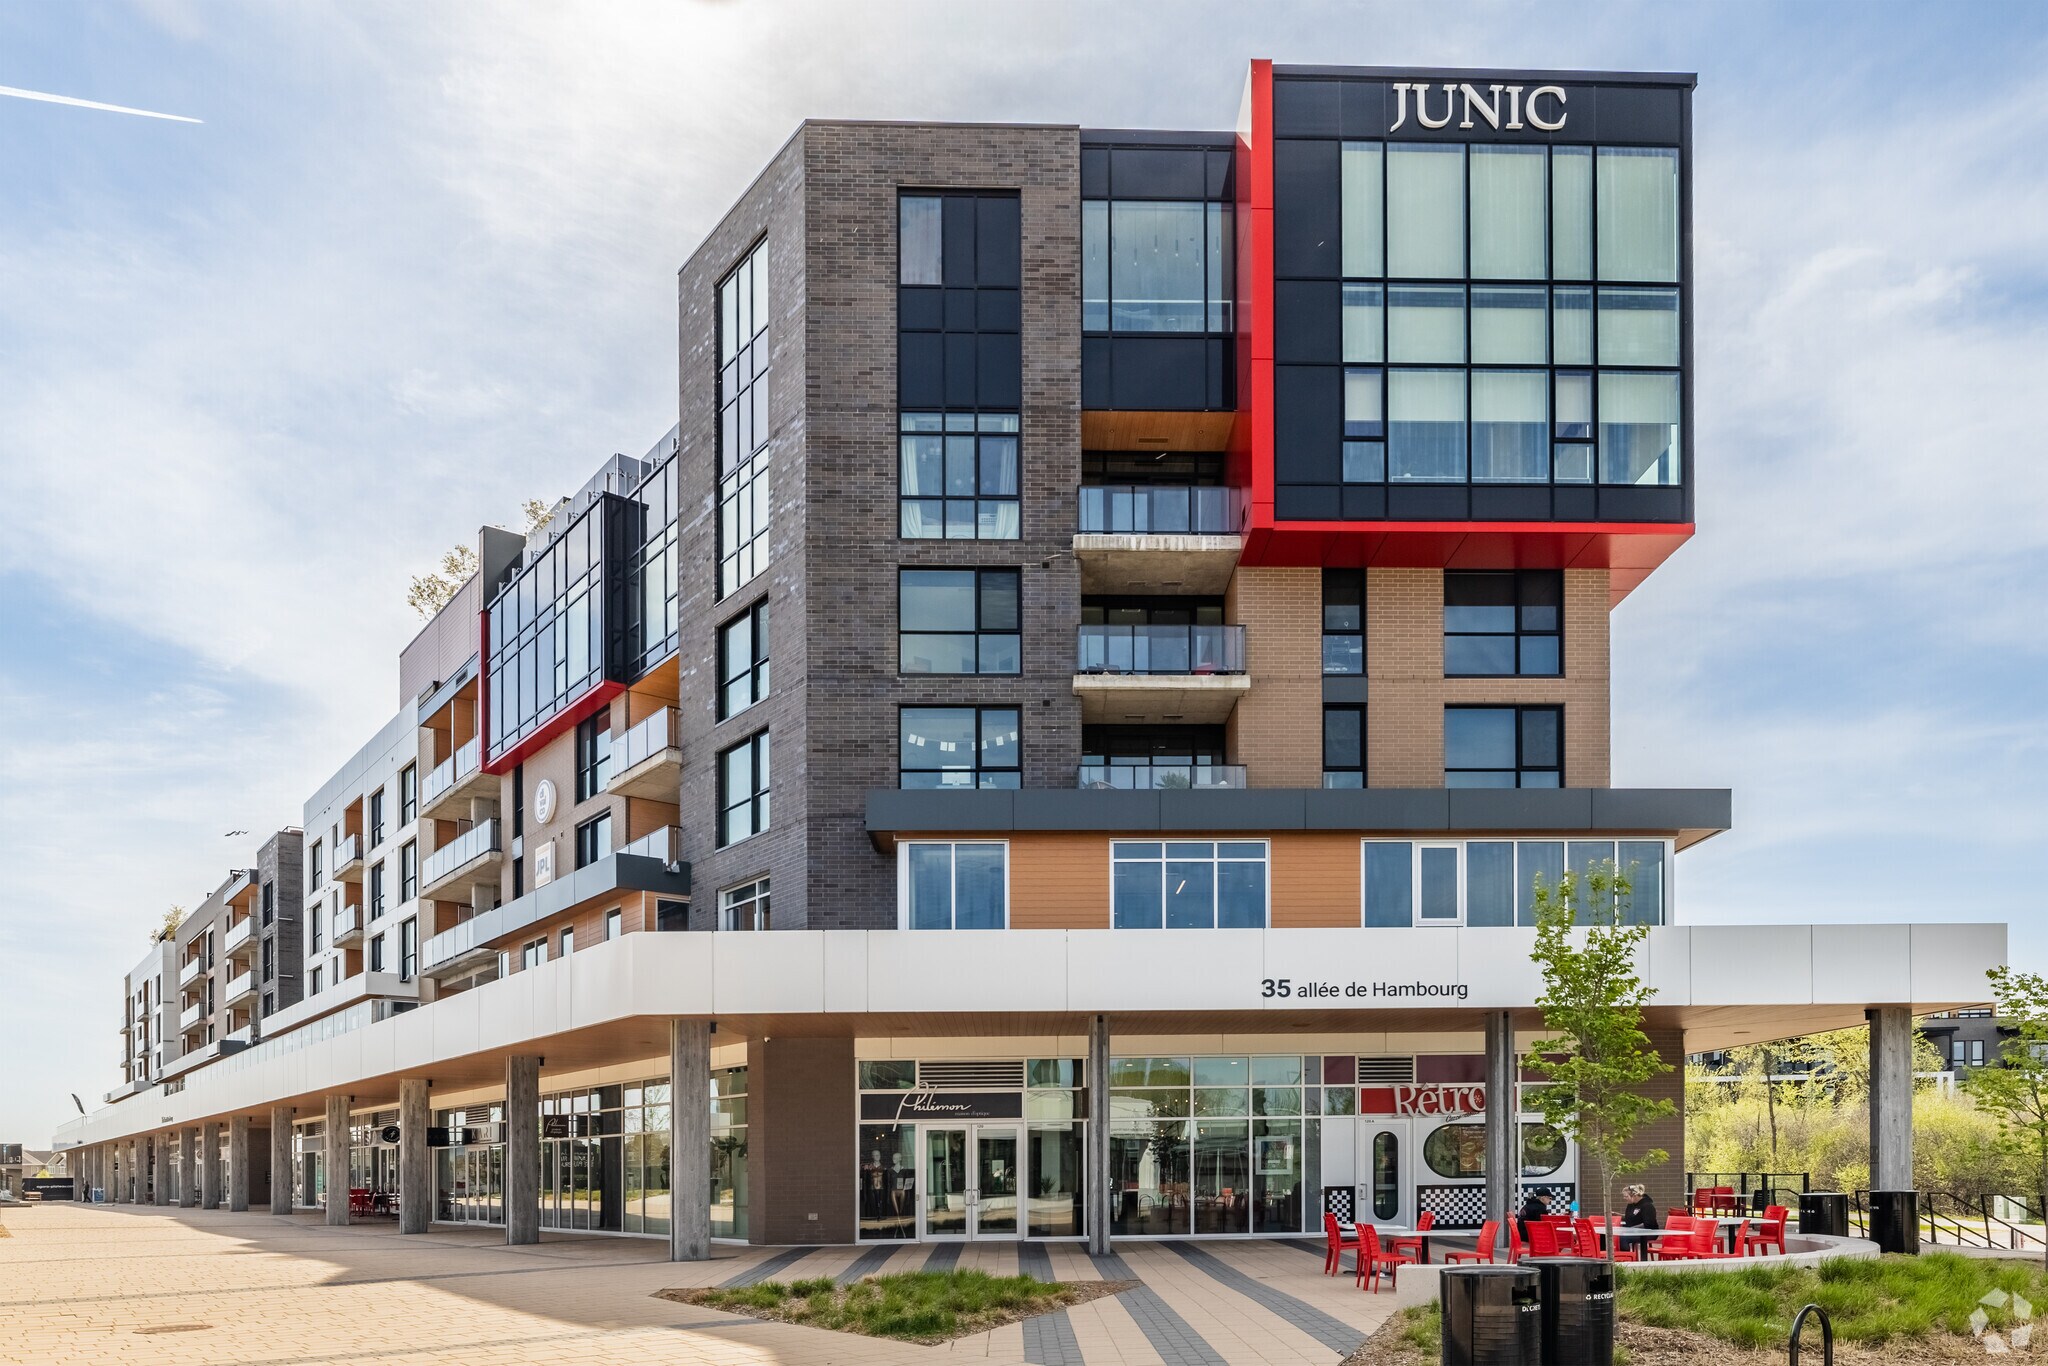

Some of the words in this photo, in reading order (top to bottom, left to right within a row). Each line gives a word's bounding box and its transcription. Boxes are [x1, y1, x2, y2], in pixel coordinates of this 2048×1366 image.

[1390, 83, 1567, 132] JUNIC
[536, 857, 549, 876] JPL
[1261, 978, 1291, 998] 35
[1297, 981, 1340, 998] allée
[1345, 981, 1367, 997] de
[1373, 981, 1468, 999] Hambourg
[892, 1081, 972, 1132] Philémon
[1390, 1082, 1486, 1118] Rétro
